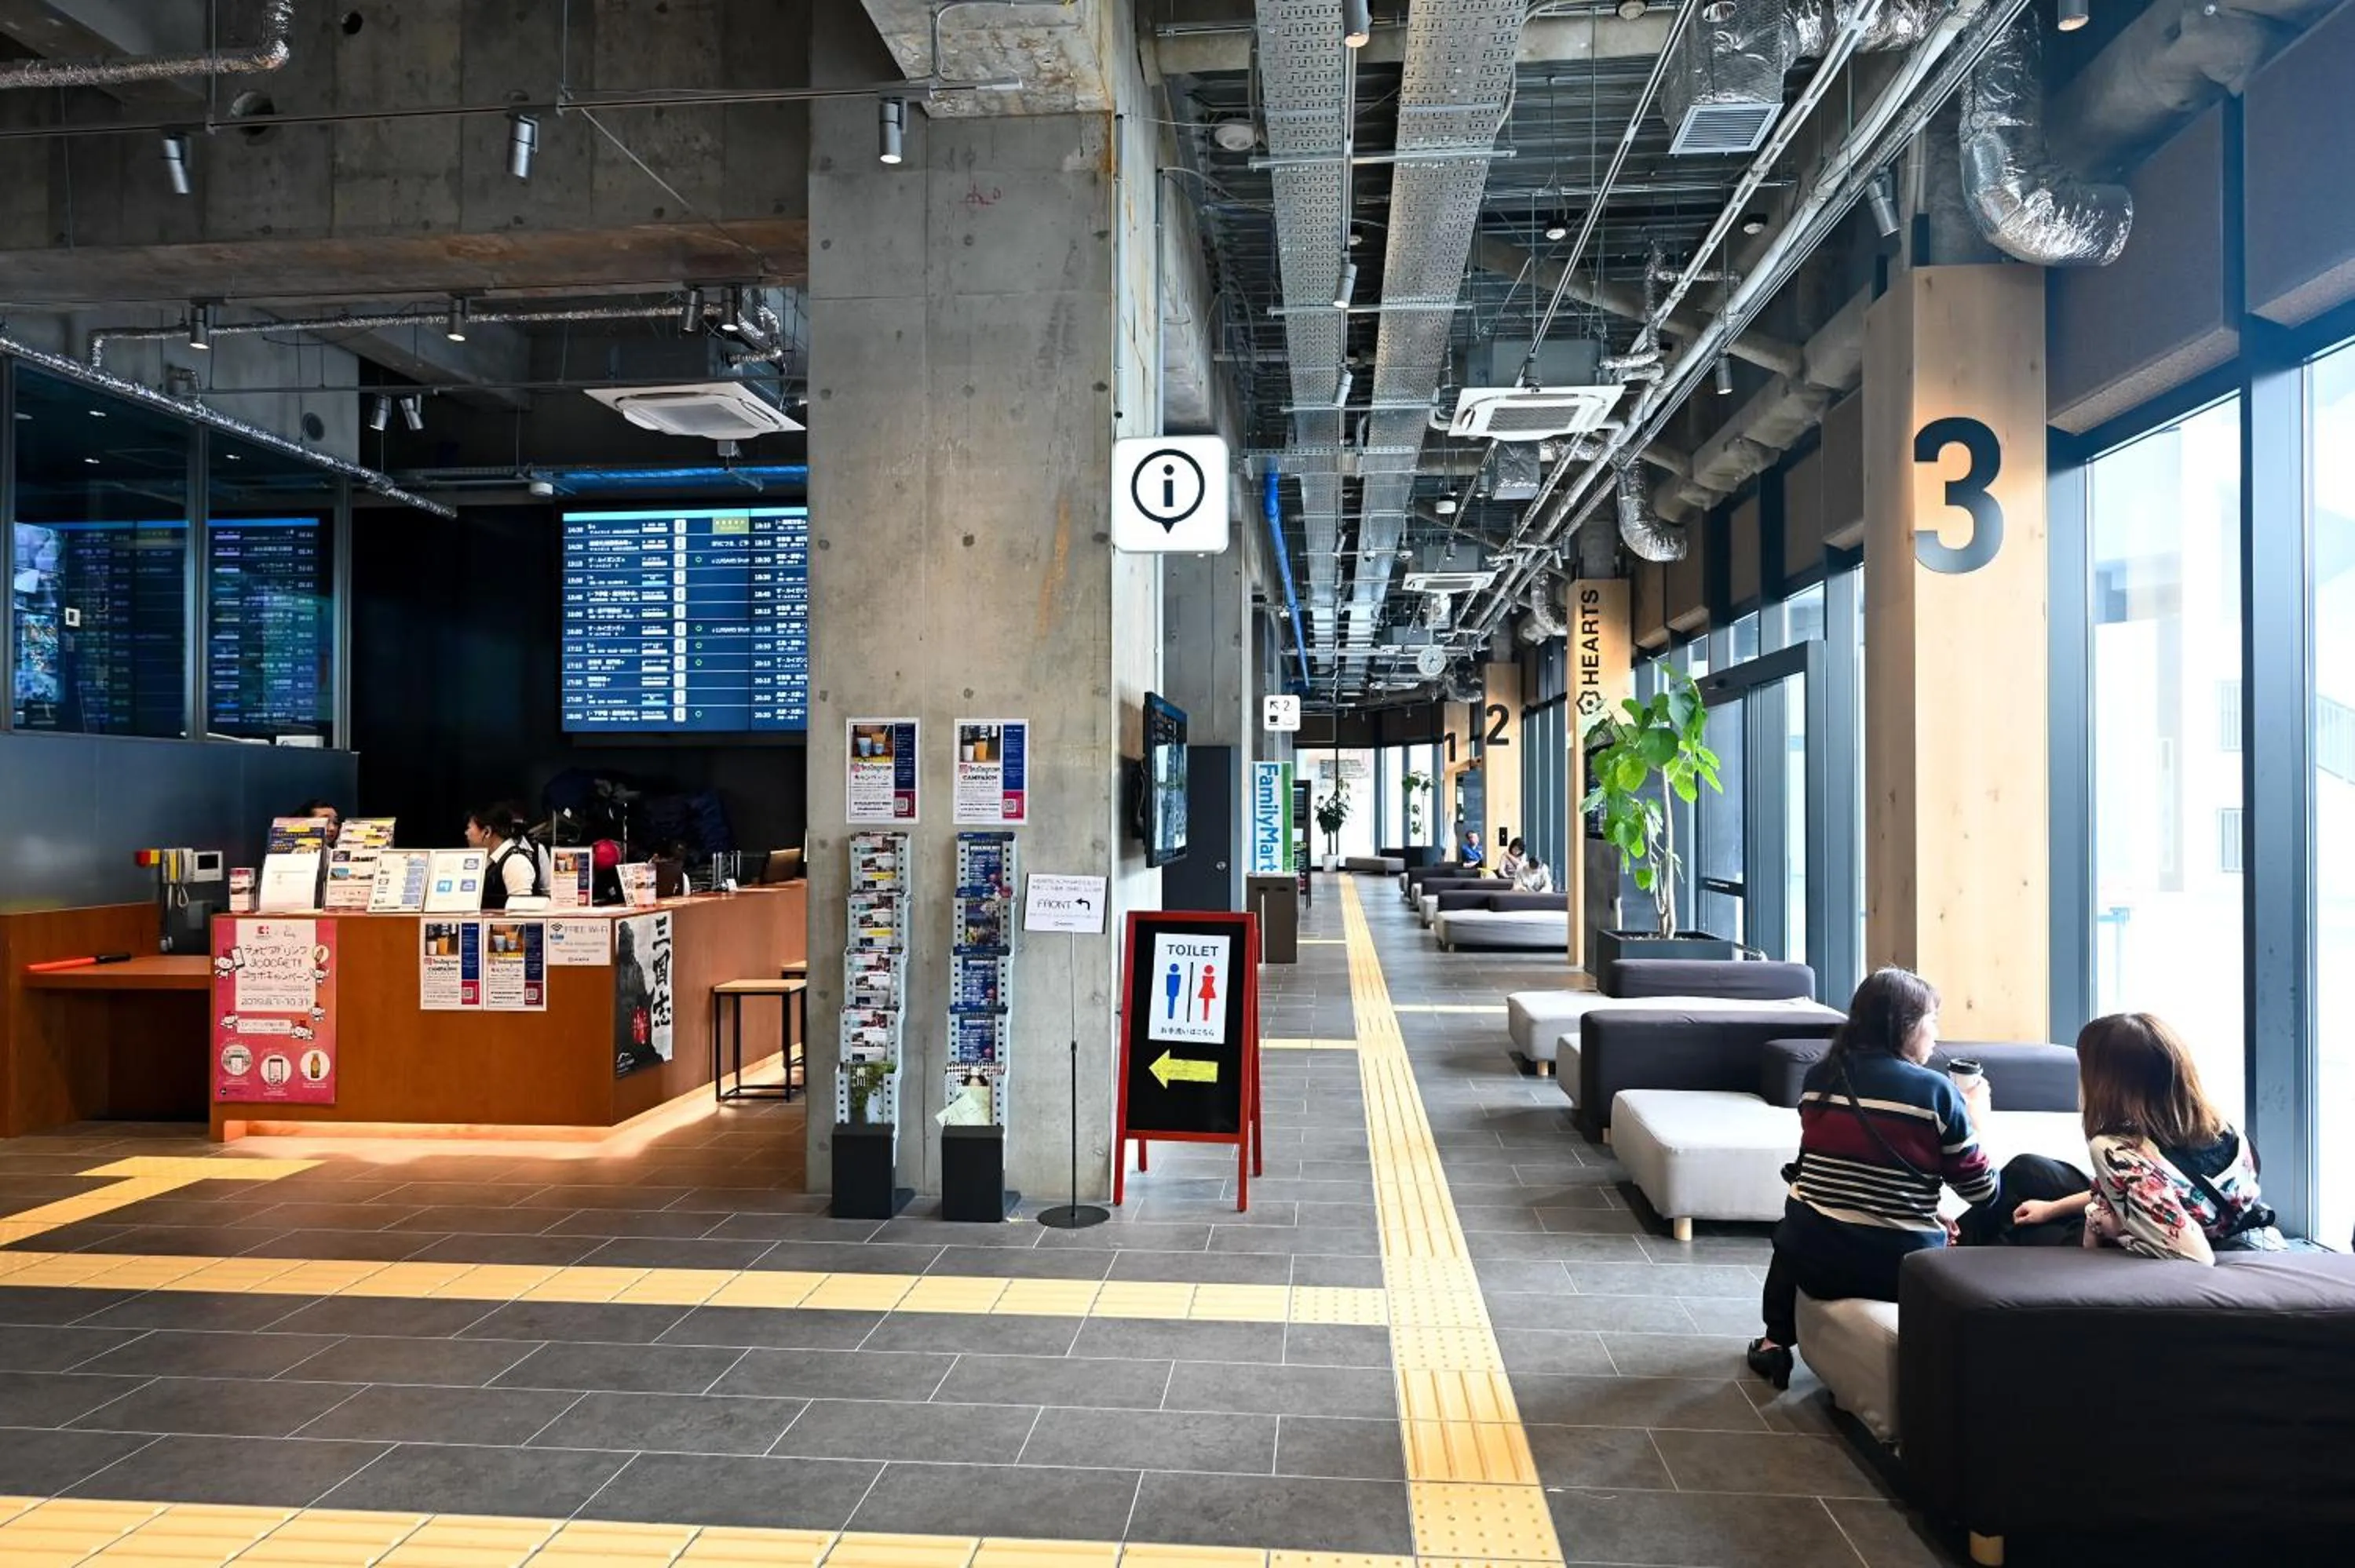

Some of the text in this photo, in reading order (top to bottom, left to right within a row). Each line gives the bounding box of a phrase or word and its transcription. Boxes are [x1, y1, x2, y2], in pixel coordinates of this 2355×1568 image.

[1914, 417, 2004, 574] 3
[1580, 589, 1599, 685] HEARTS
[1486, 704, 1510, 746] 2
[1444, 732, 1456, 762] 1
[1258, 764, 1280, 872] FamilyMart
[1037, 898, 1072, 910] FRONT
[1167, 944, 1219, 957] TOILET
[1160, 1026, 1215, 1037] お手洗いはこちら
